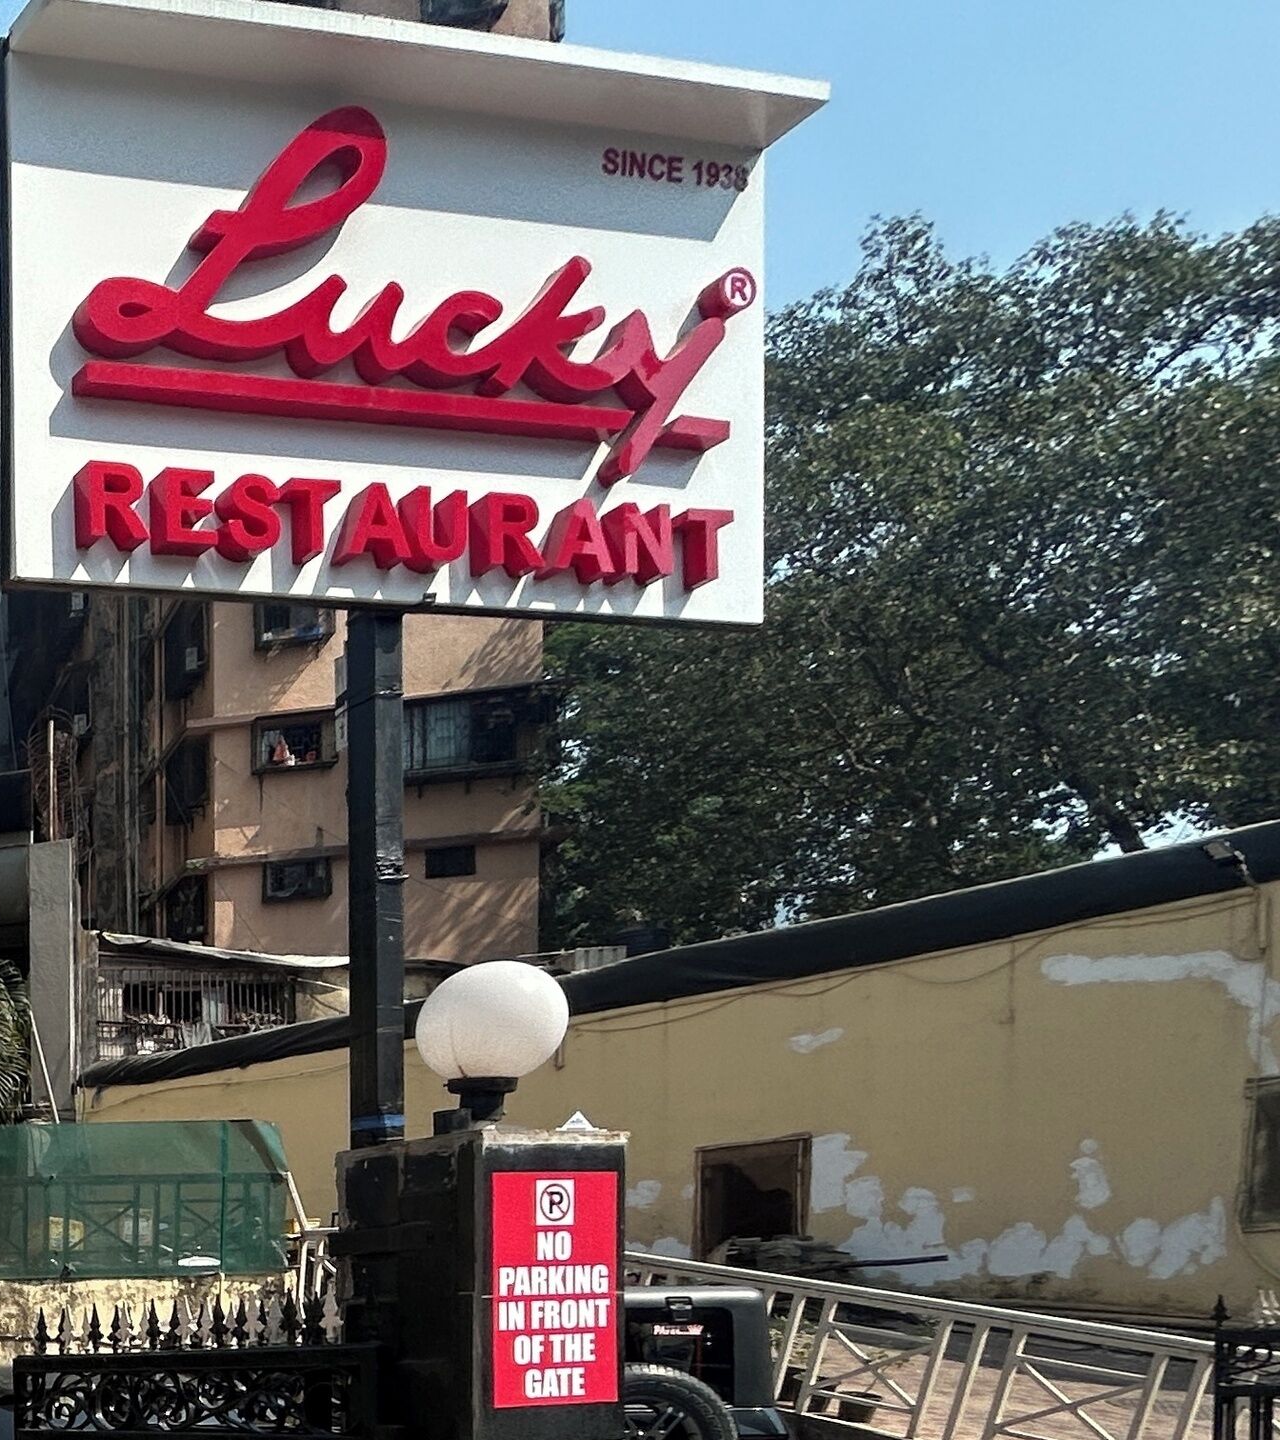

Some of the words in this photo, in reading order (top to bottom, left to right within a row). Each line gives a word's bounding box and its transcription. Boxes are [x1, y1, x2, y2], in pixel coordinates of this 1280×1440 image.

[601, 147, 685, 184] SINCE
[692, 160, 749, 192] 1938
[73, 105, 727, 487] Lucky
[74, 459, 735, 592] RESTAURANT
[536, 1230, 573, 1261] NO
[498, 1264, 610, 1296] PARKING
[498, 1301, 525, 1331] IN
[530, 1298, 611, 1330] FRONT
[513, 1334, 545, 1365] OF
[548, 1332, 596, 1363] THE
[524, 1367, 586, 1399] GATE
